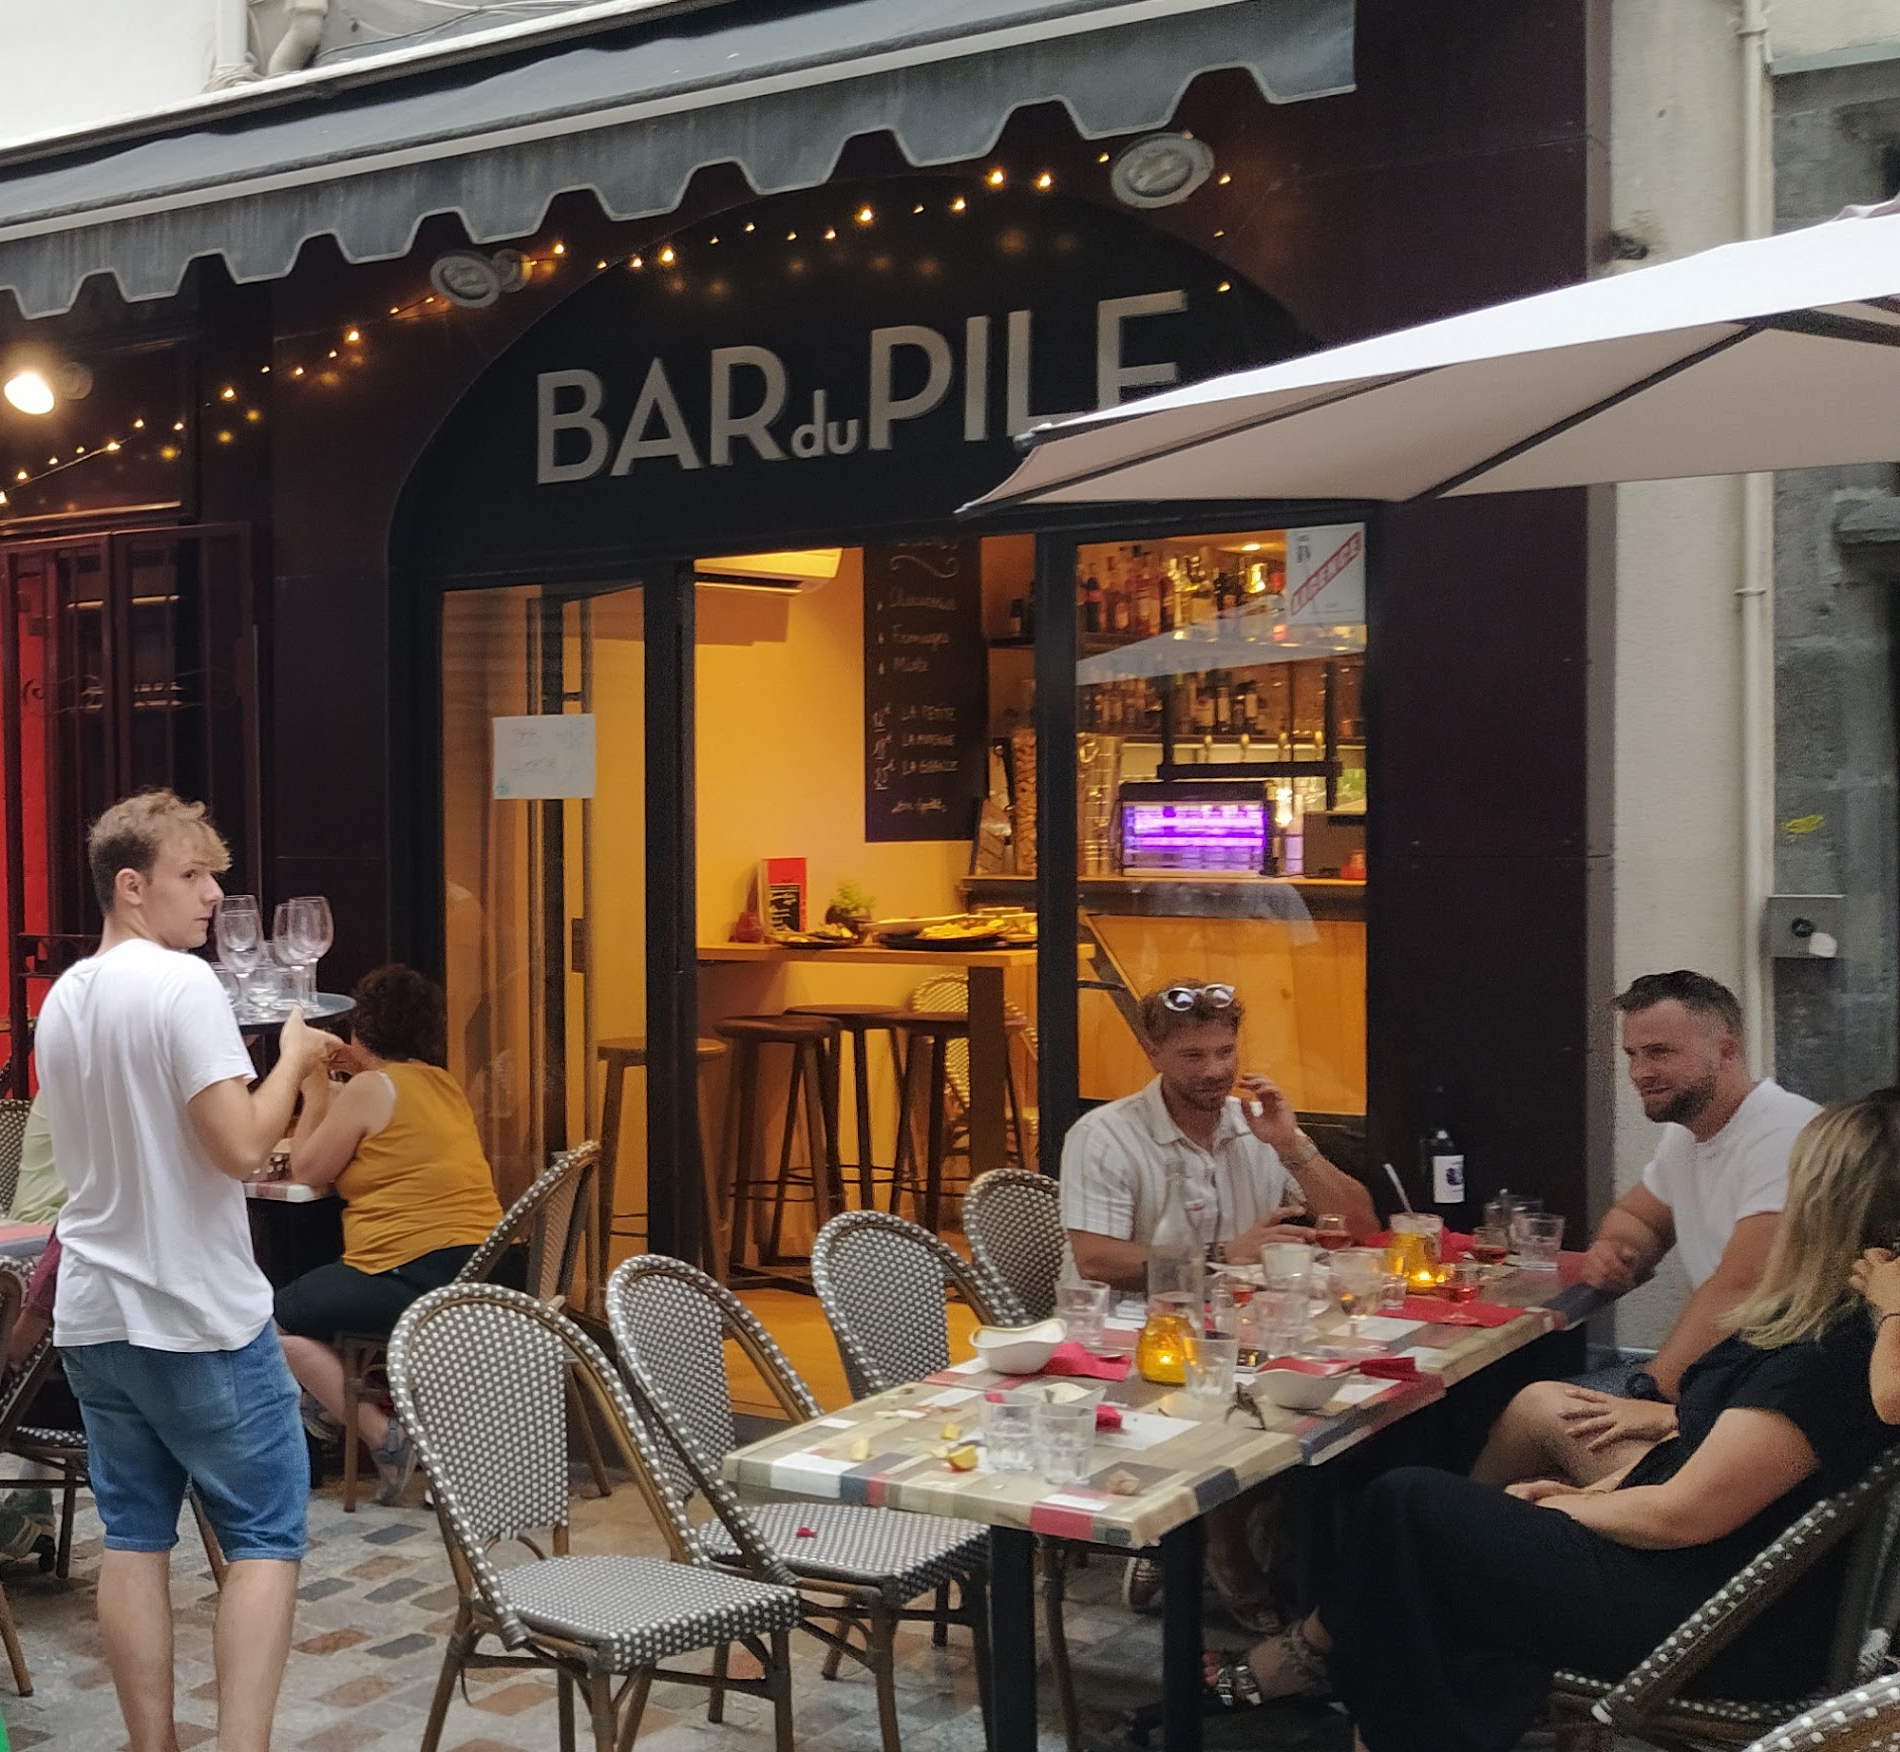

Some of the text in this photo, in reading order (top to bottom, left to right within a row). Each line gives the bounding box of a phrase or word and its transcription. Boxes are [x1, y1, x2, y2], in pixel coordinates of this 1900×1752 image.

[536, 290, 1188, 485] BAR du PILE
